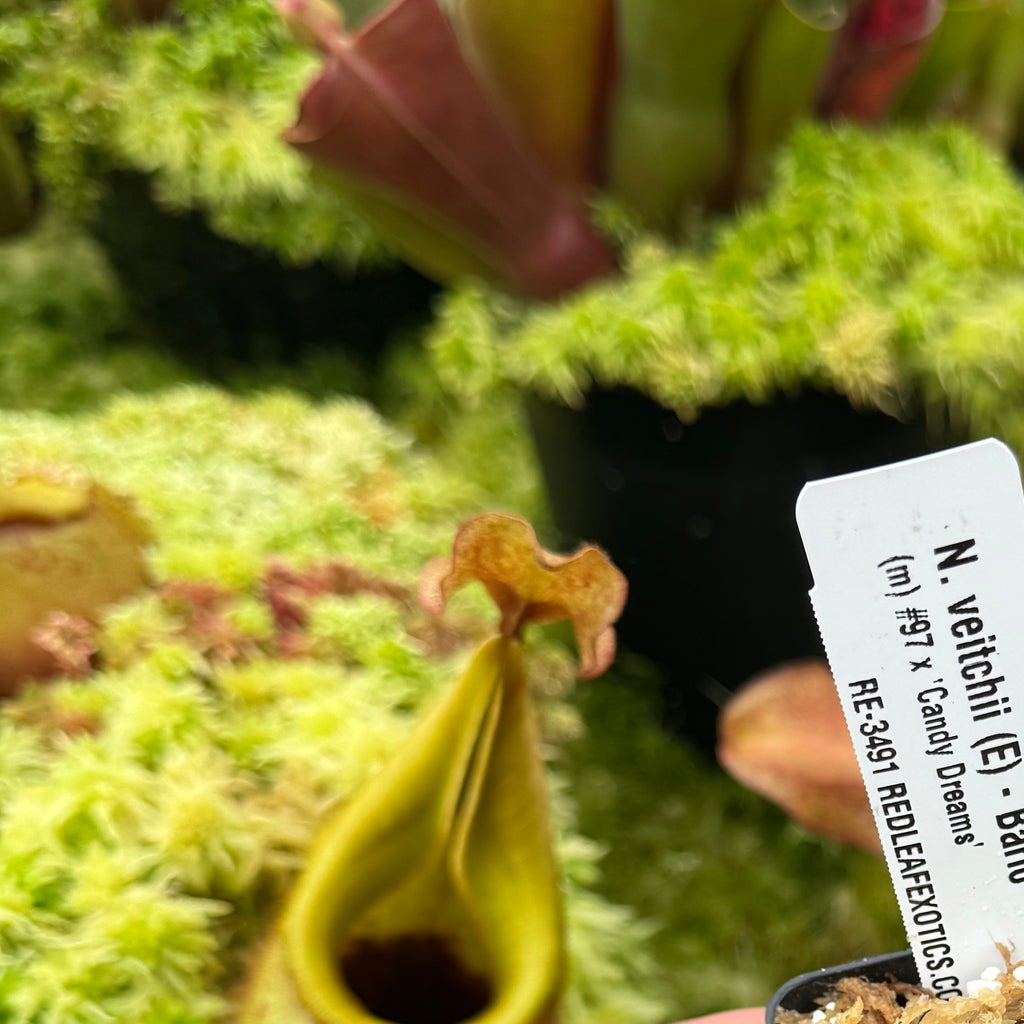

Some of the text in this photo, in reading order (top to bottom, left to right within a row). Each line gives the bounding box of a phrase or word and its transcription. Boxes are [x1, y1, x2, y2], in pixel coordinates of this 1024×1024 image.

[933, 538, 978, 584] N.
[877, 555, 984, 847] (m) #97 x 'Candy Dreams'
[947, 594, 1012, 722] veitchii
[848, 678, 900, 774] RE-3491
[970, 732, 1023, 775] (E)
